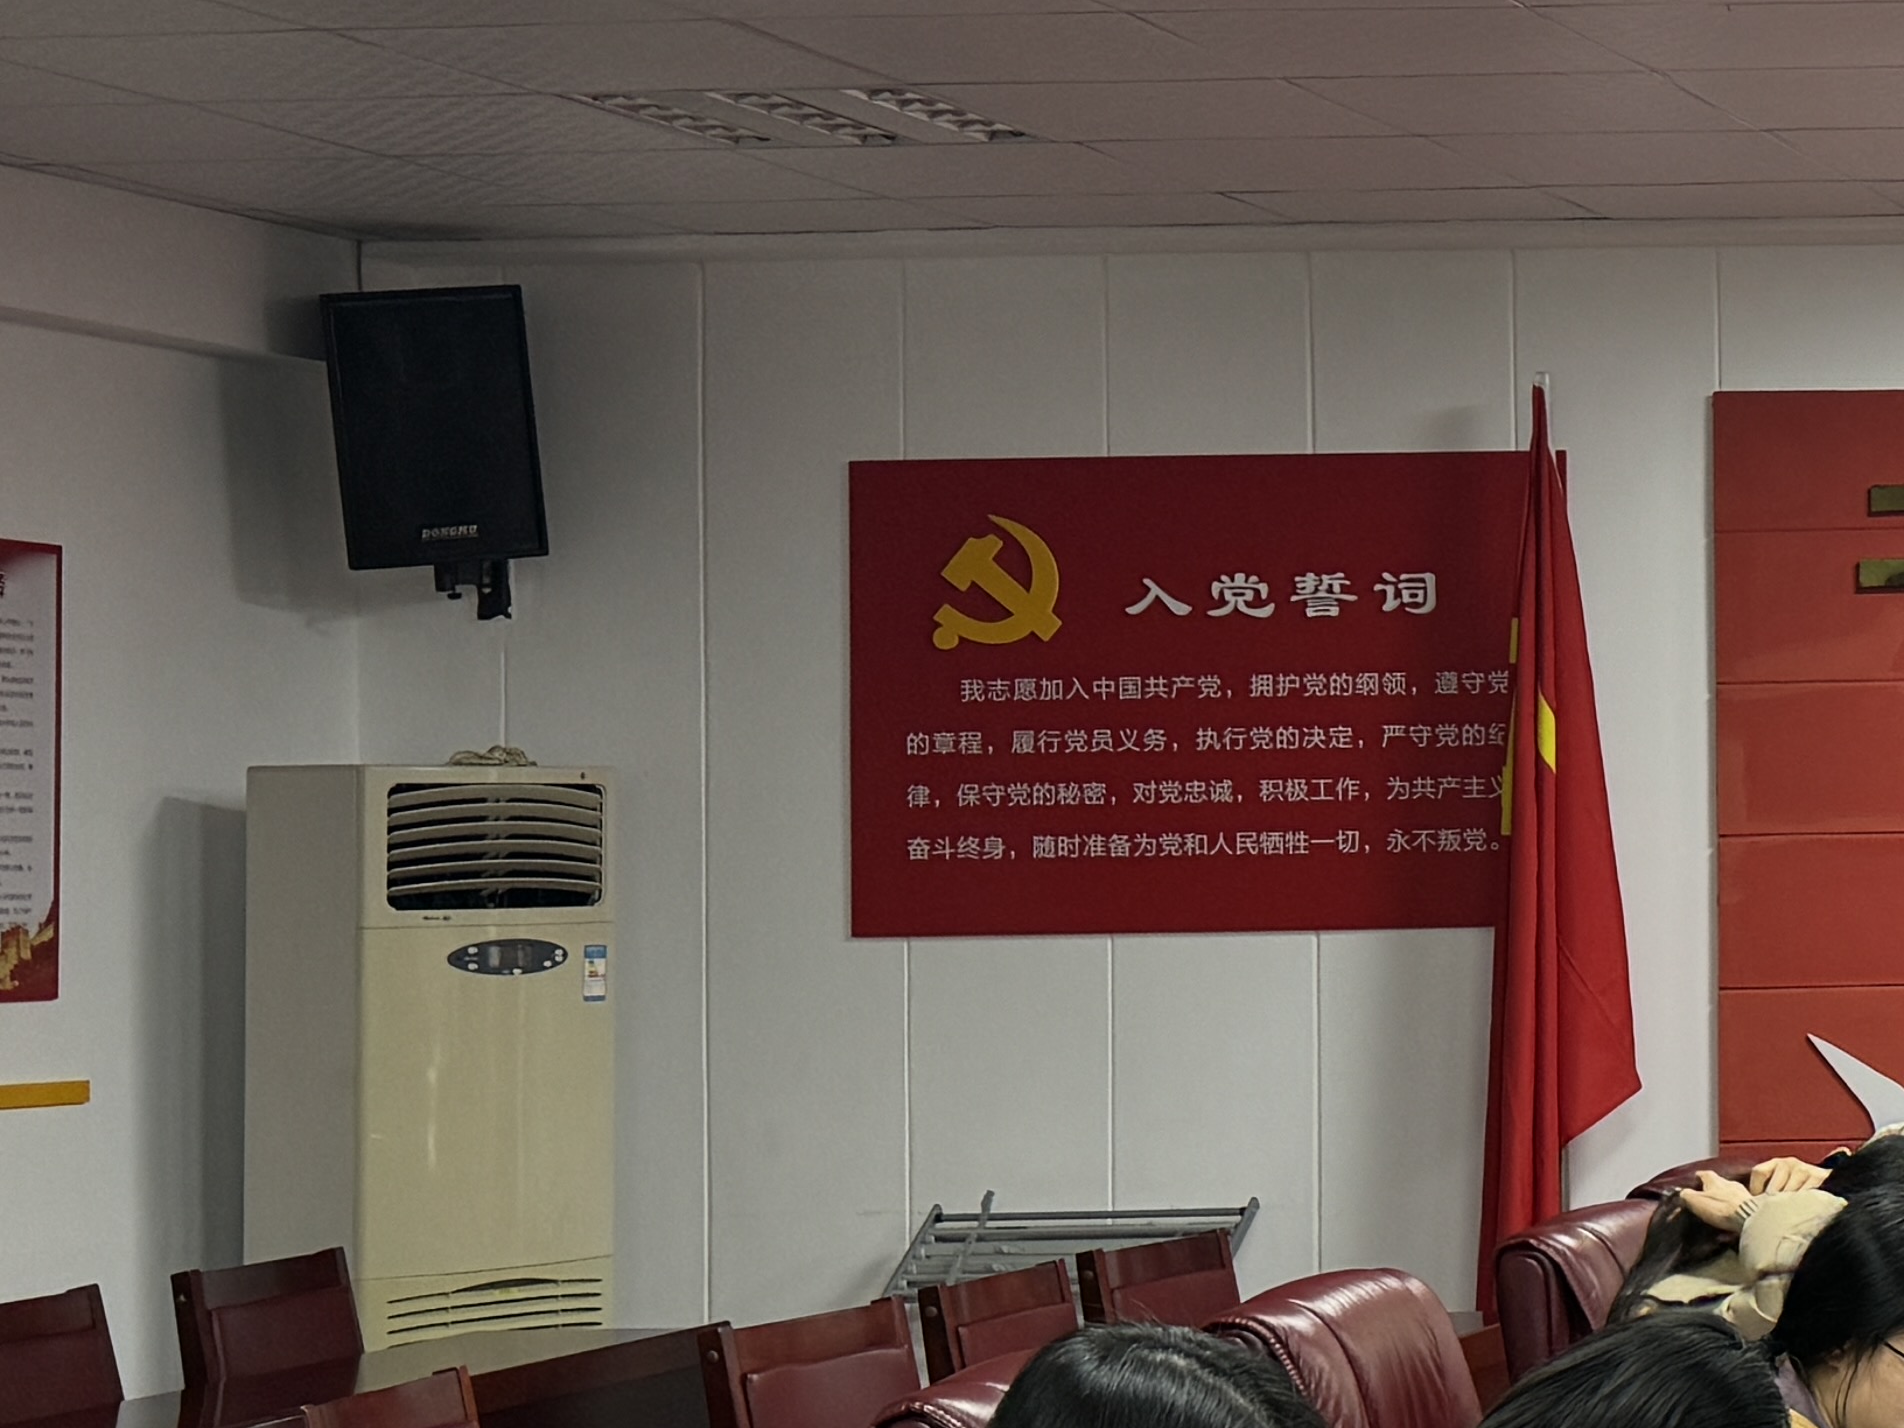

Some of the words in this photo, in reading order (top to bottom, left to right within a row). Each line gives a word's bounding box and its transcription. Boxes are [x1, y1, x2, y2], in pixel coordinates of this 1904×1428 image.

[1124, 570, 1438, 619] 入党誓词
[906, 827, 1501, 861] 奋斗终身，随时准备为党和人民牺牲一切，永不叛党。
